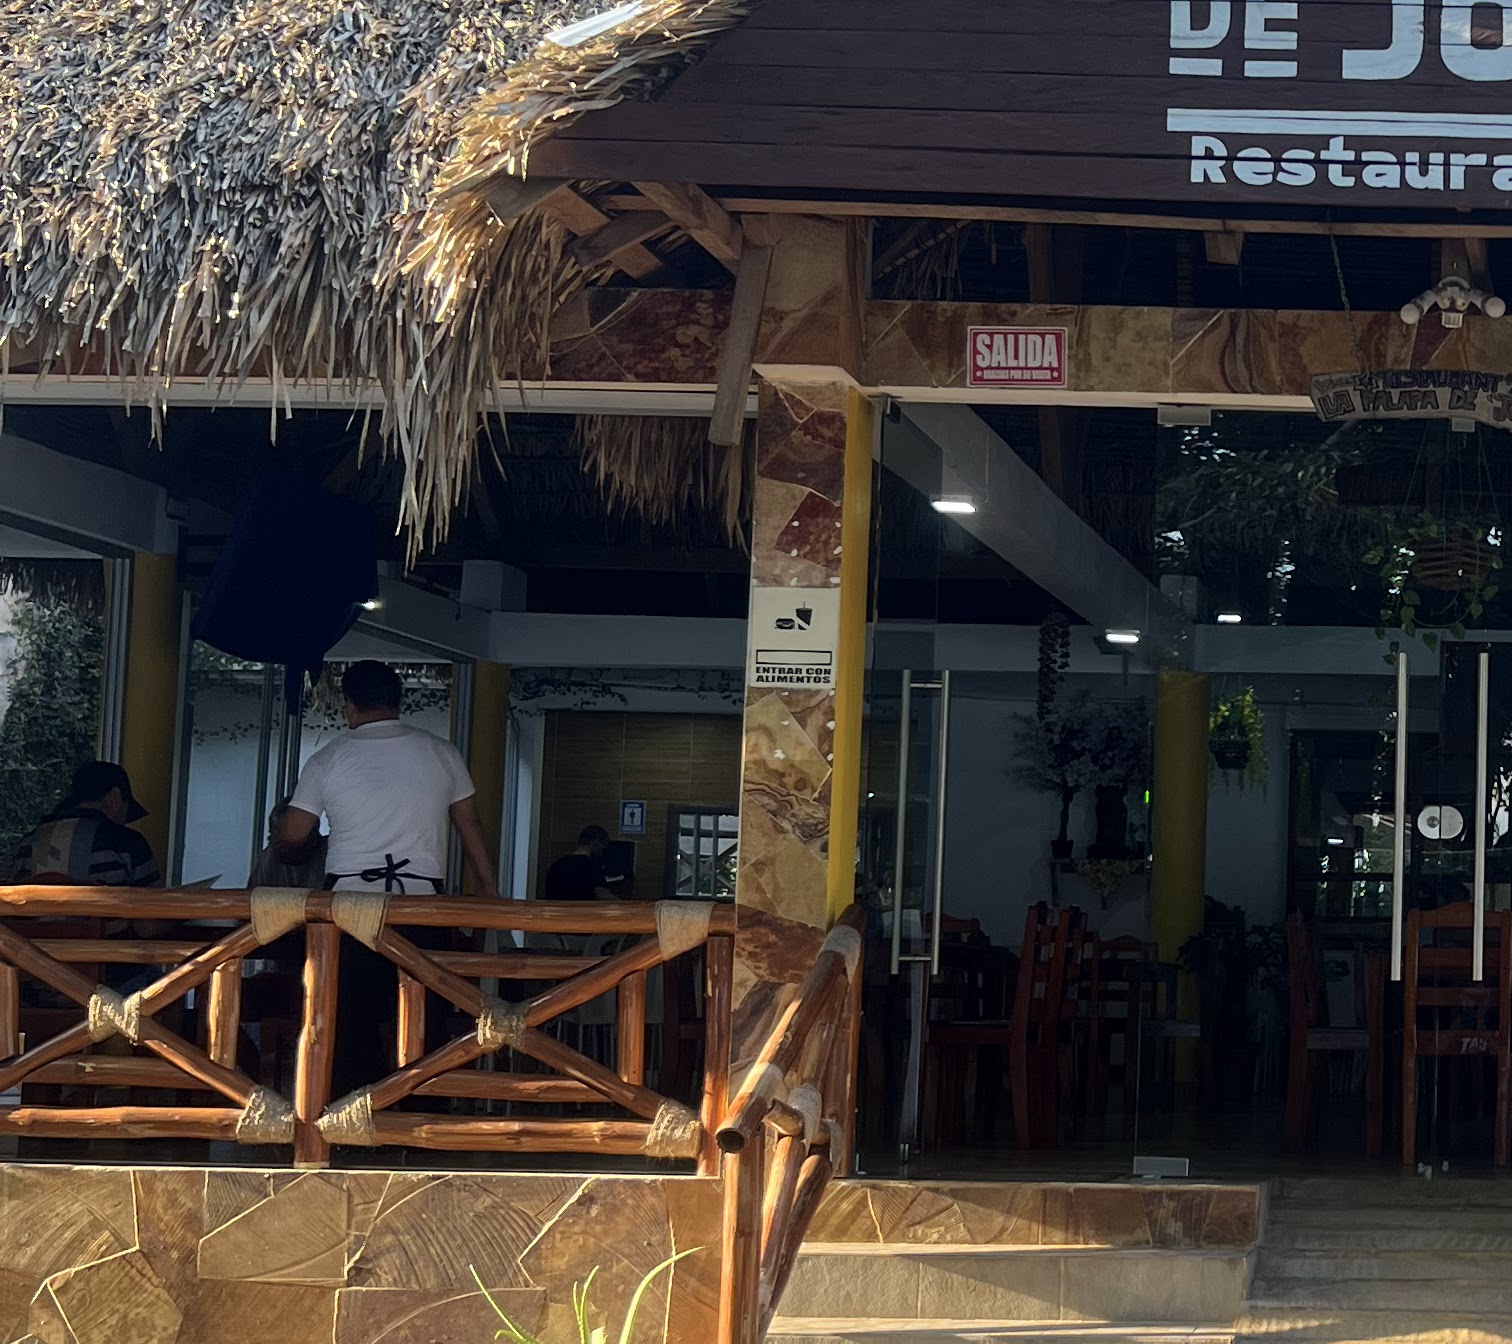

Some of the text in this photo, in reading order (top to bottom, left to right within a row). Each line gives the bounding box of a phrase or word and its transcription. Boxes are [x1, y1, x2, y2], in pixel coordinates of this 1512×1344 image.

[975, 333, 1059, 368] SALIDA
[1318, 390, 1355, 420] LA
[1360, 390, 1439, 412] PALAPA
[1448, 388, 1478, 411] DE
[755, 666, 832, 676] ENTRAR CON
[755, 675, 831, 684] ALIMENTOS
